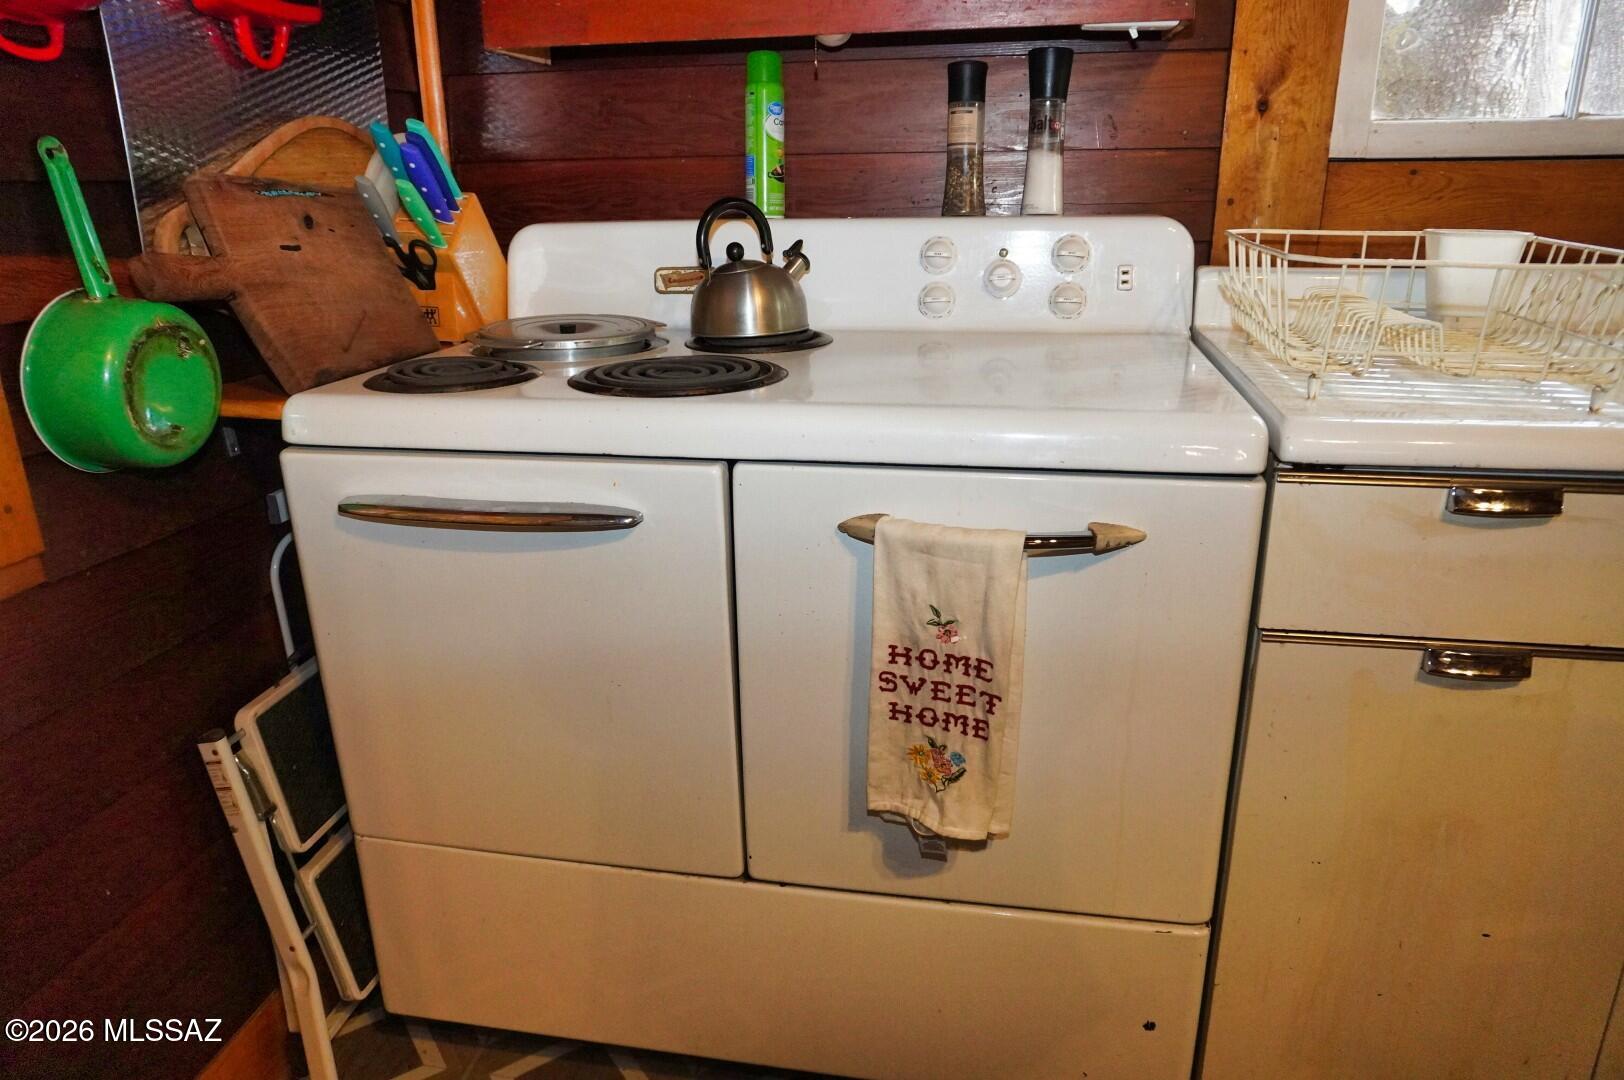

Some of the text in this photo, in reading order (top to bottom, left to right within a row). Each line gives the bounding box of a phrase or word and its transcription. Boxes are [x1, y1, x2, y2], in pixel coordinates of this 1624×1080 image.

[888, 644, 994, 683] HOME
[878, 671, 1002, 715] SWEET
[888, 702, 990, 741] HOME
